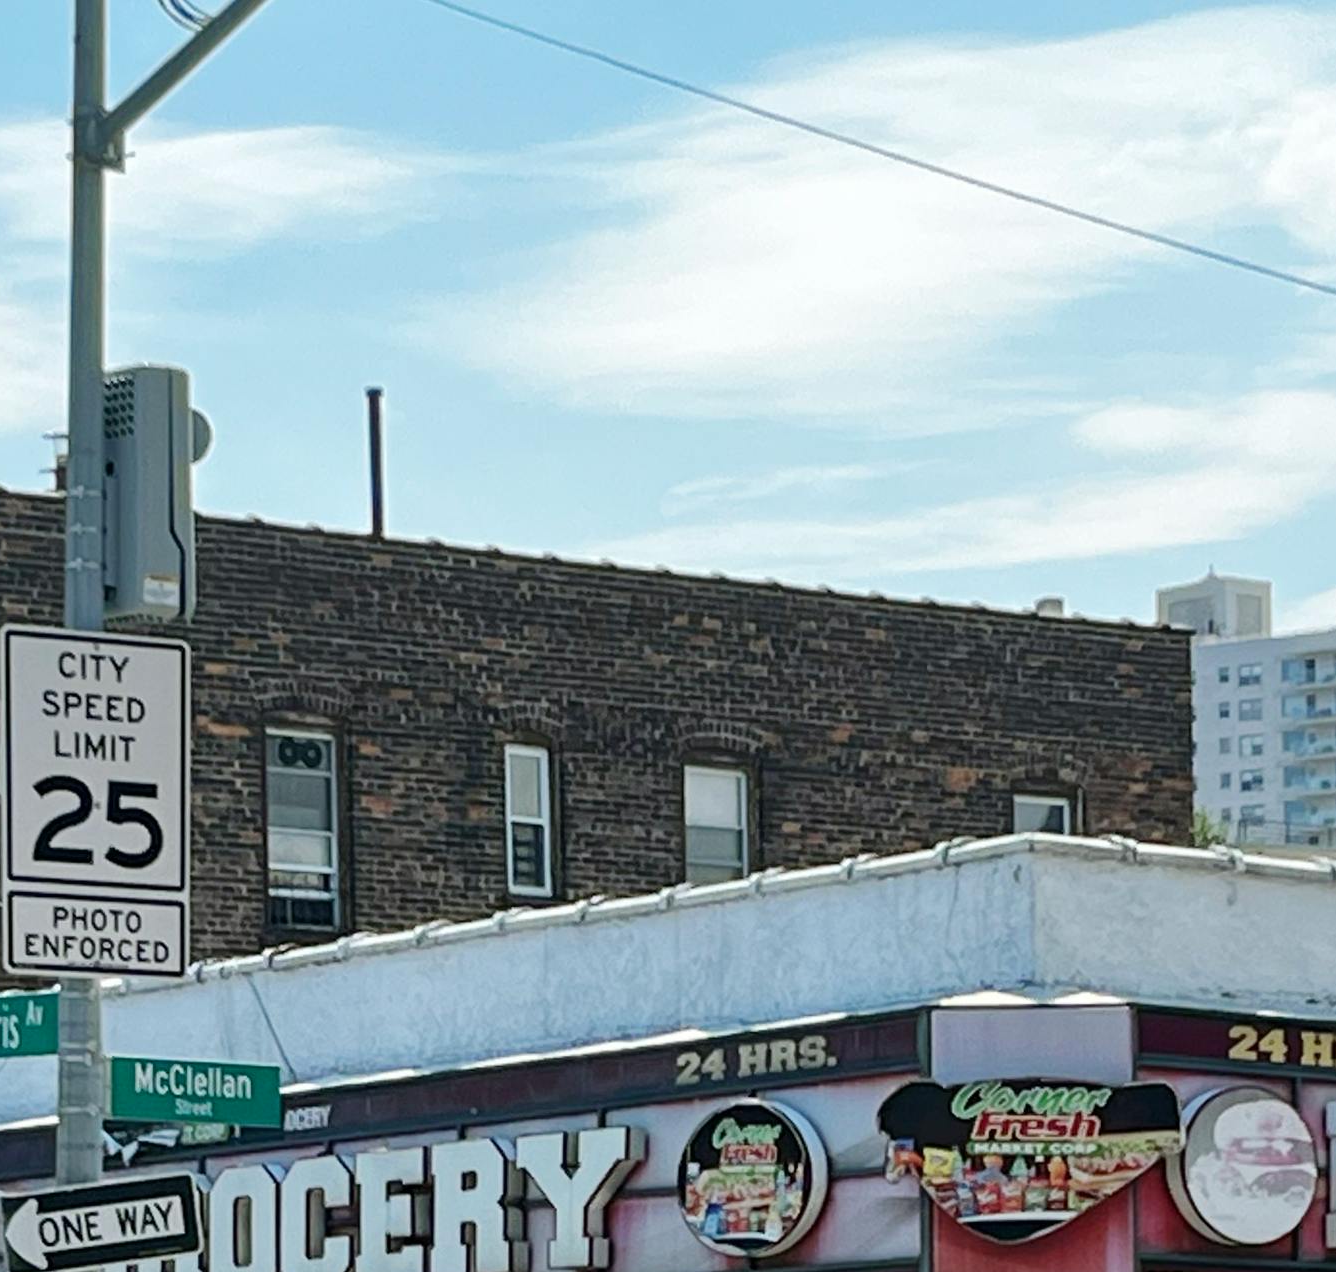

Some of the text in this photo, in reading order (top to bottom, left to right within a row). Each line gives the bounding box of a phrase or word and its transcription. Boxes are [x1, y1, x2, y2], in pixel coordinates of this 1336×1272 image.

[57, 651, 130, 683] CITY
[42, 690, 146, 723] SPEED
[54, 730, 136, 763] LIMIT
[32, 774, 164, 870] 25
[52, 905, 143, 934] PHOTO
[24, 934, 170, 964] ENFORCED
[25, 1000, 44, 1027] Av
[675, 1035, 838, 1086] 24 HRS.
[1228, 1025, 1288, 1064] 24
[134, 1061, 252, 1100] McClellan
[174, 1098, 214, 1117] Street
[951, 1080, 1113, 1120] Corner
[970, 1111, 1102, 1141] Fresh
[972, 1142, 1098, 1154] MARKET CORP
[38, 1201, 174, 1247] ONE WAY
